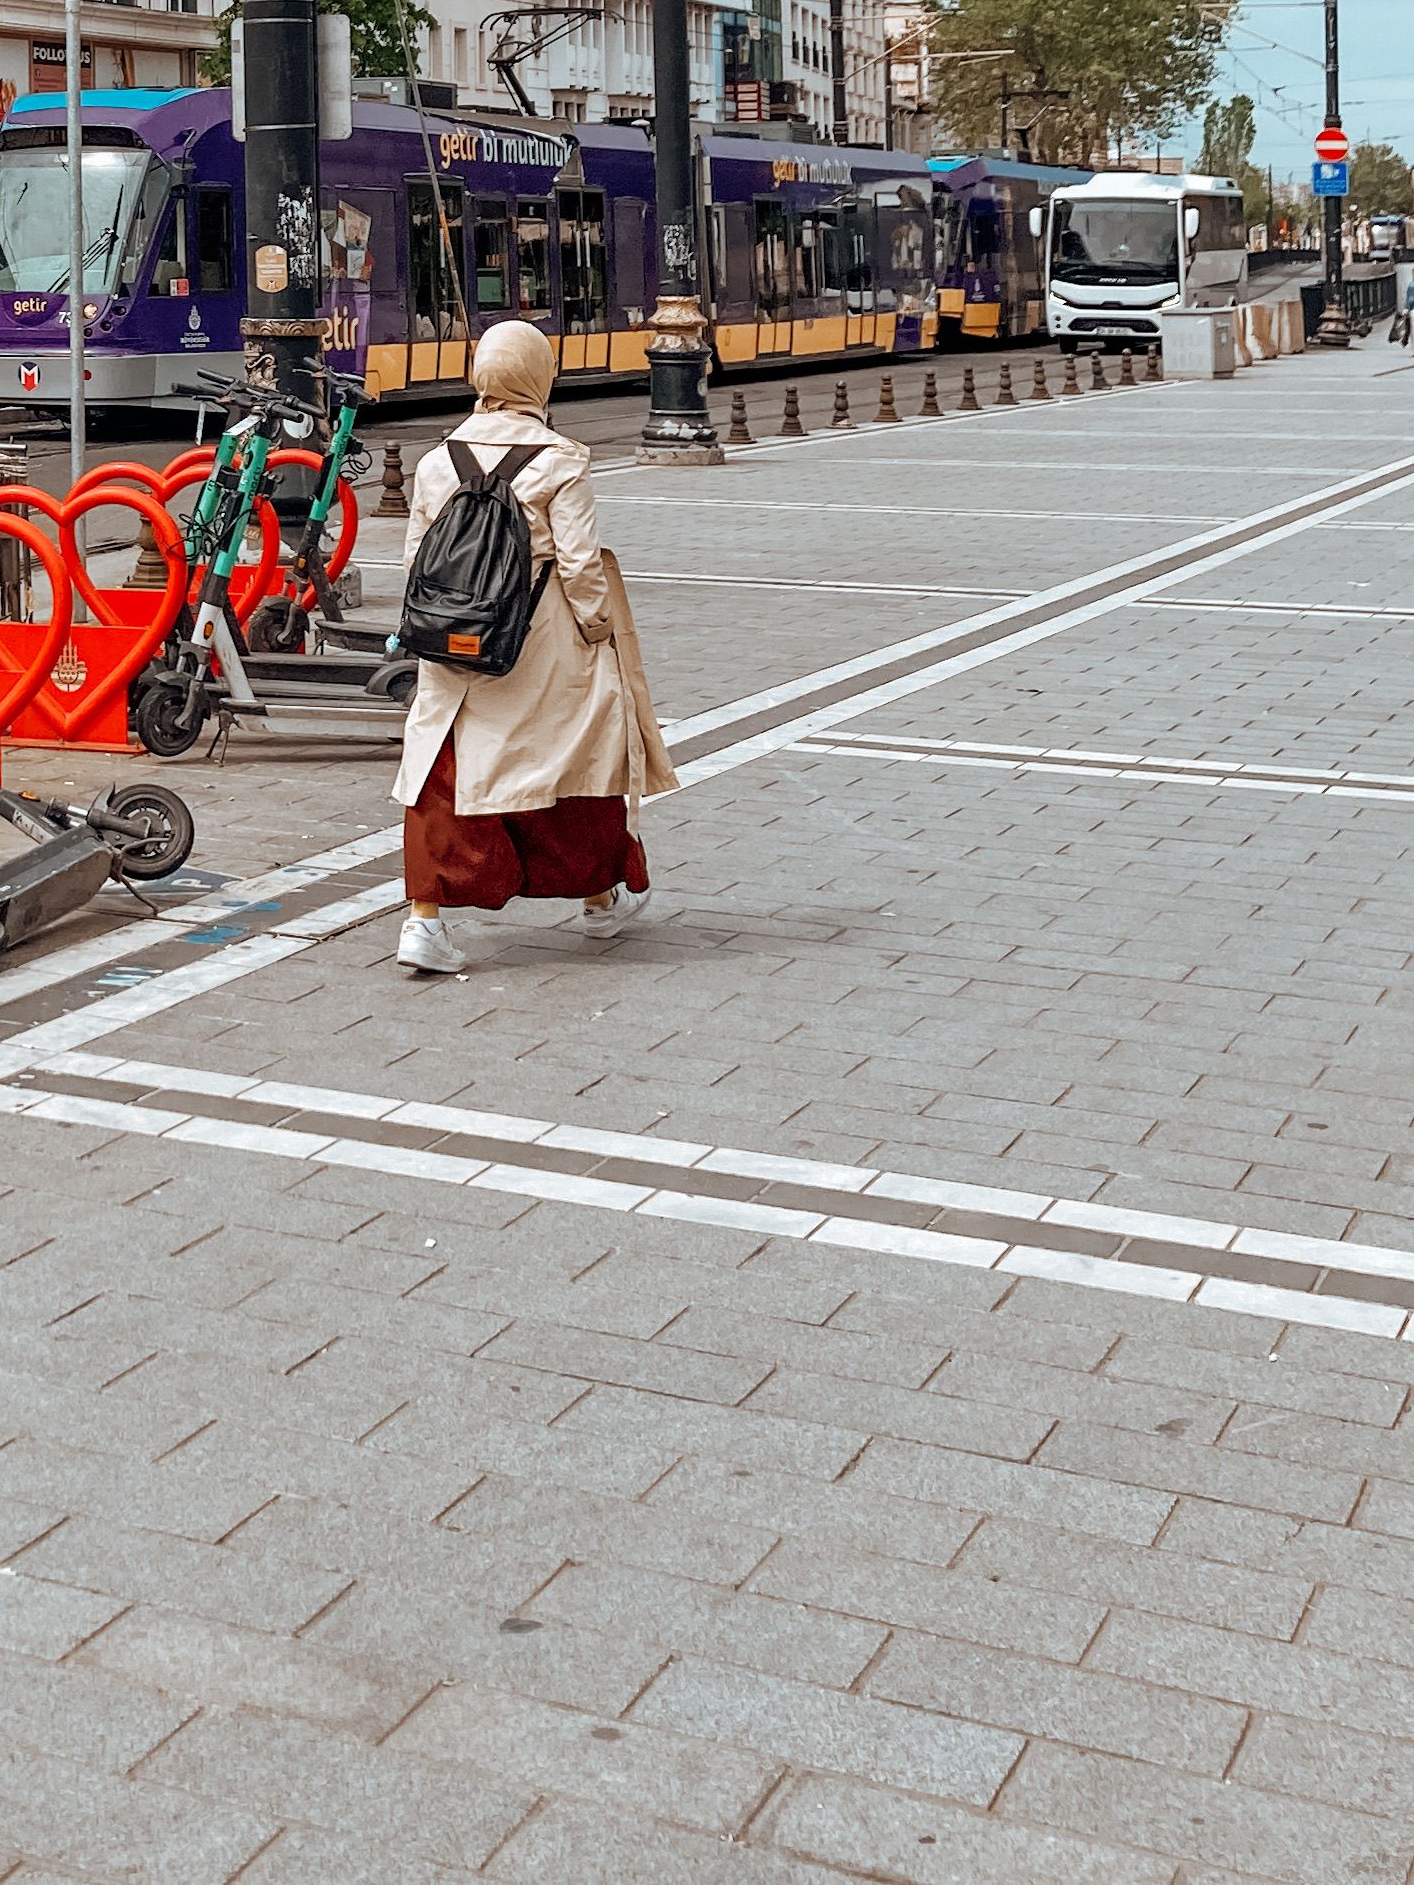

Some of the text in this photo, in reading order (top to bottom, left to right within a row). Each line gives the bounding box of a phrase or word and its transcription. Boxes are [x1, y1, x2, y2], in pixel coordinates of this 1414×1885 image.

[33, 46, 66, 62] FOLLO
[439, 128, 479, 169] getir
[13, 297, 48, 315] getir
